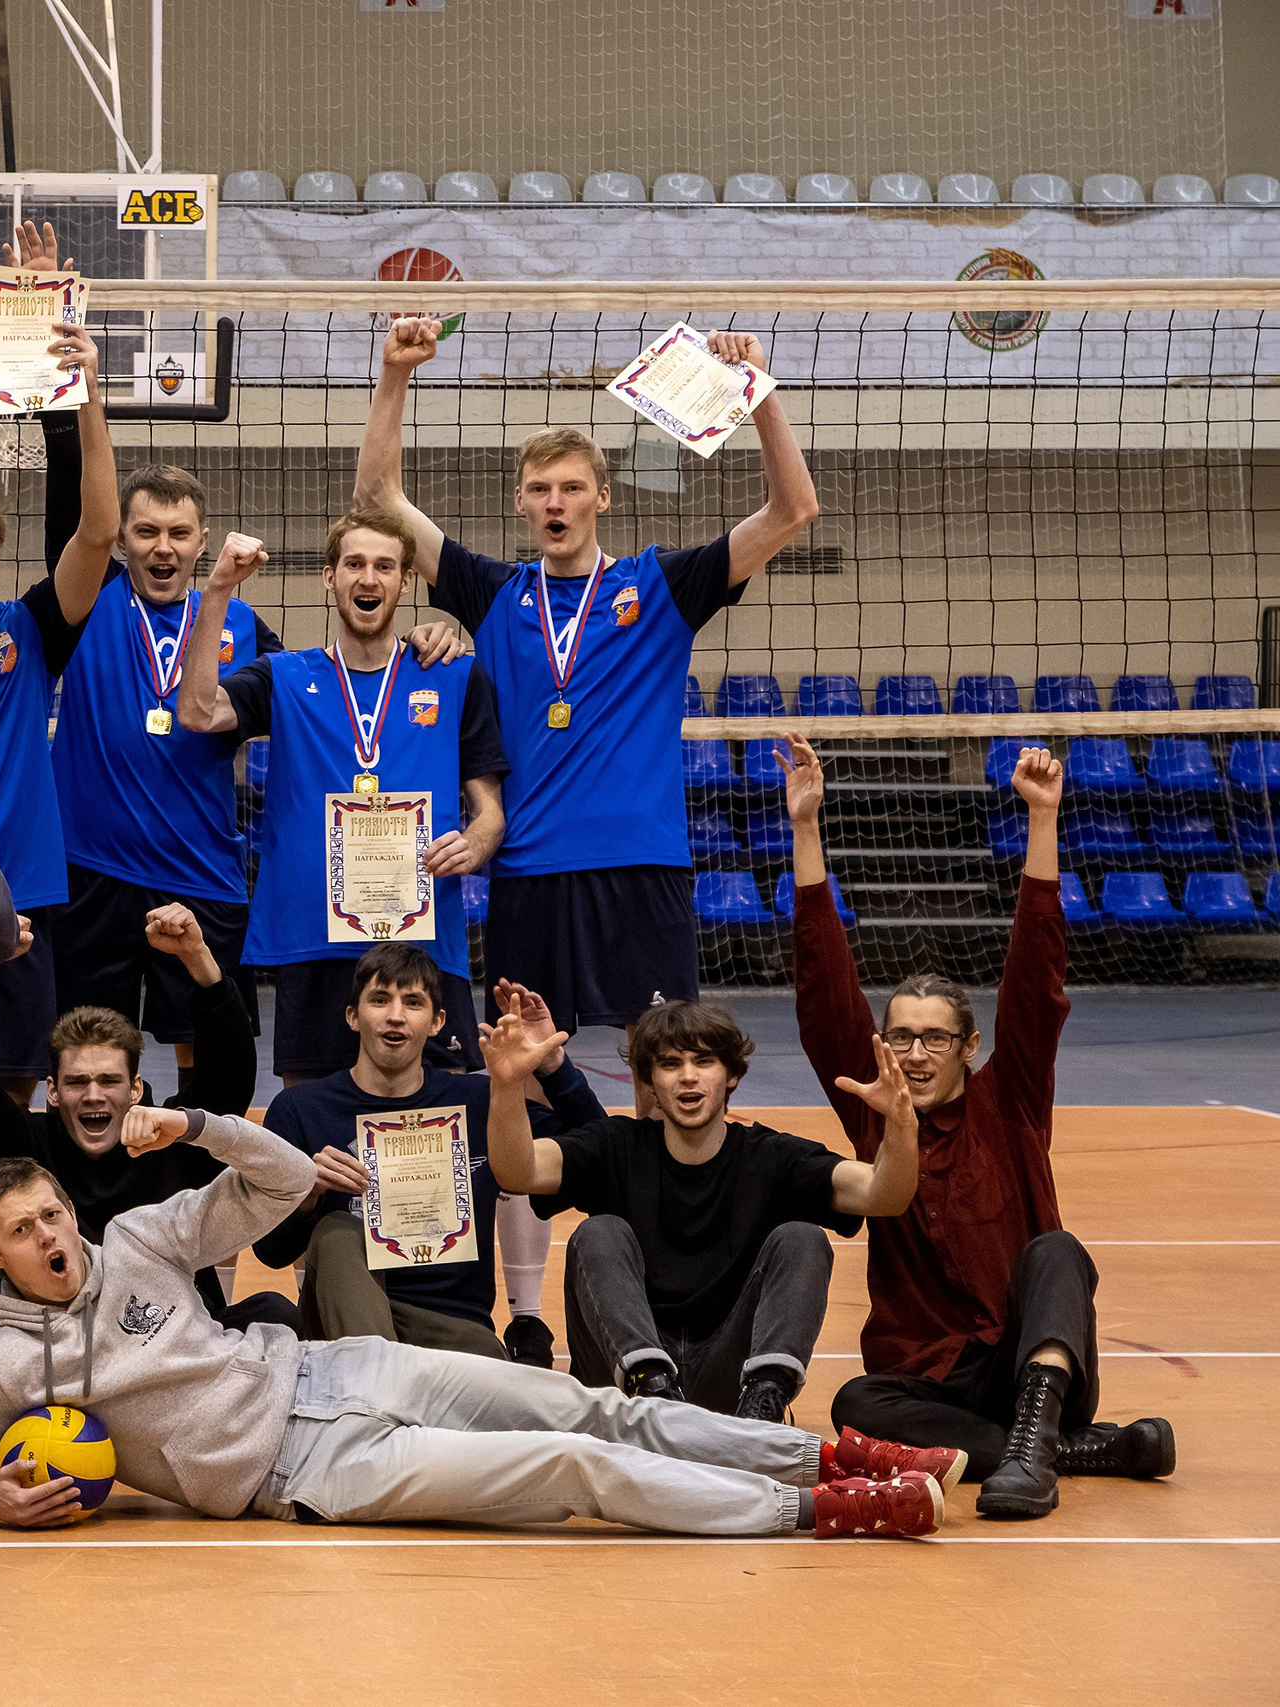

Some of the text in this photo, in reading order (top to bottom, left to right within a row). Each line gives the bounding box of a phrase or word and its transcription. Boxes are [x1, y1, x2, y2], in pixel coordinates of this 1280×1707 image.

[2, 334, 52, 342] НАГРАЖДАЕТ
[350, 816, 408, 837] ГРАМОТА
[354, 854, 405, 862] НАГРАЖДАЕТ
[383, 1132, 444, 1157] ГРАМОТА
[390, 1173, 442, 1184] НАГРАЖДАЕТ
